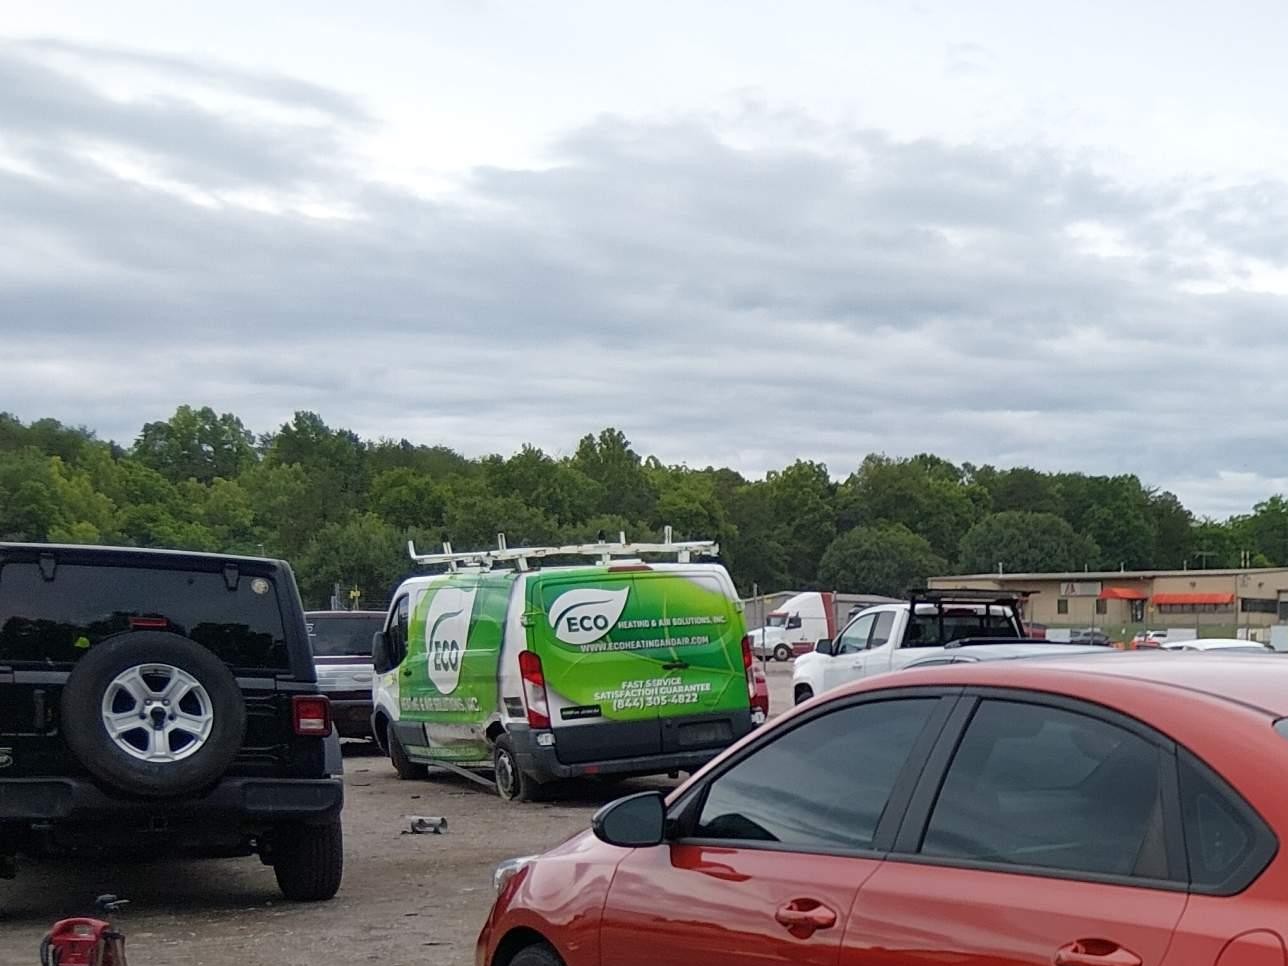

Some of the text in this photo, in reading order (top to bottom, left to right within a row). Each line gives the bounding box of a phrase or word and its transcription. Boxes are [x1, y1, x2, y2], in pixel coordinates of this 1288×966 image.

[566, 614, 609, 633] ECO
[618, 619, 650, 629] HEATING
[658, 618, 671, 627] AIR
[580, 636, 709, 653] WWW.ECOHEATINGANDAIR.COM
[434, 639, 460, 672] ECO
[594, 682, 711, 701] SATISFACTION GUARANTEE
[622, 677, 682, 690] FAST SERVICE
[613, 693, 698, 711] (844) 305-4822
